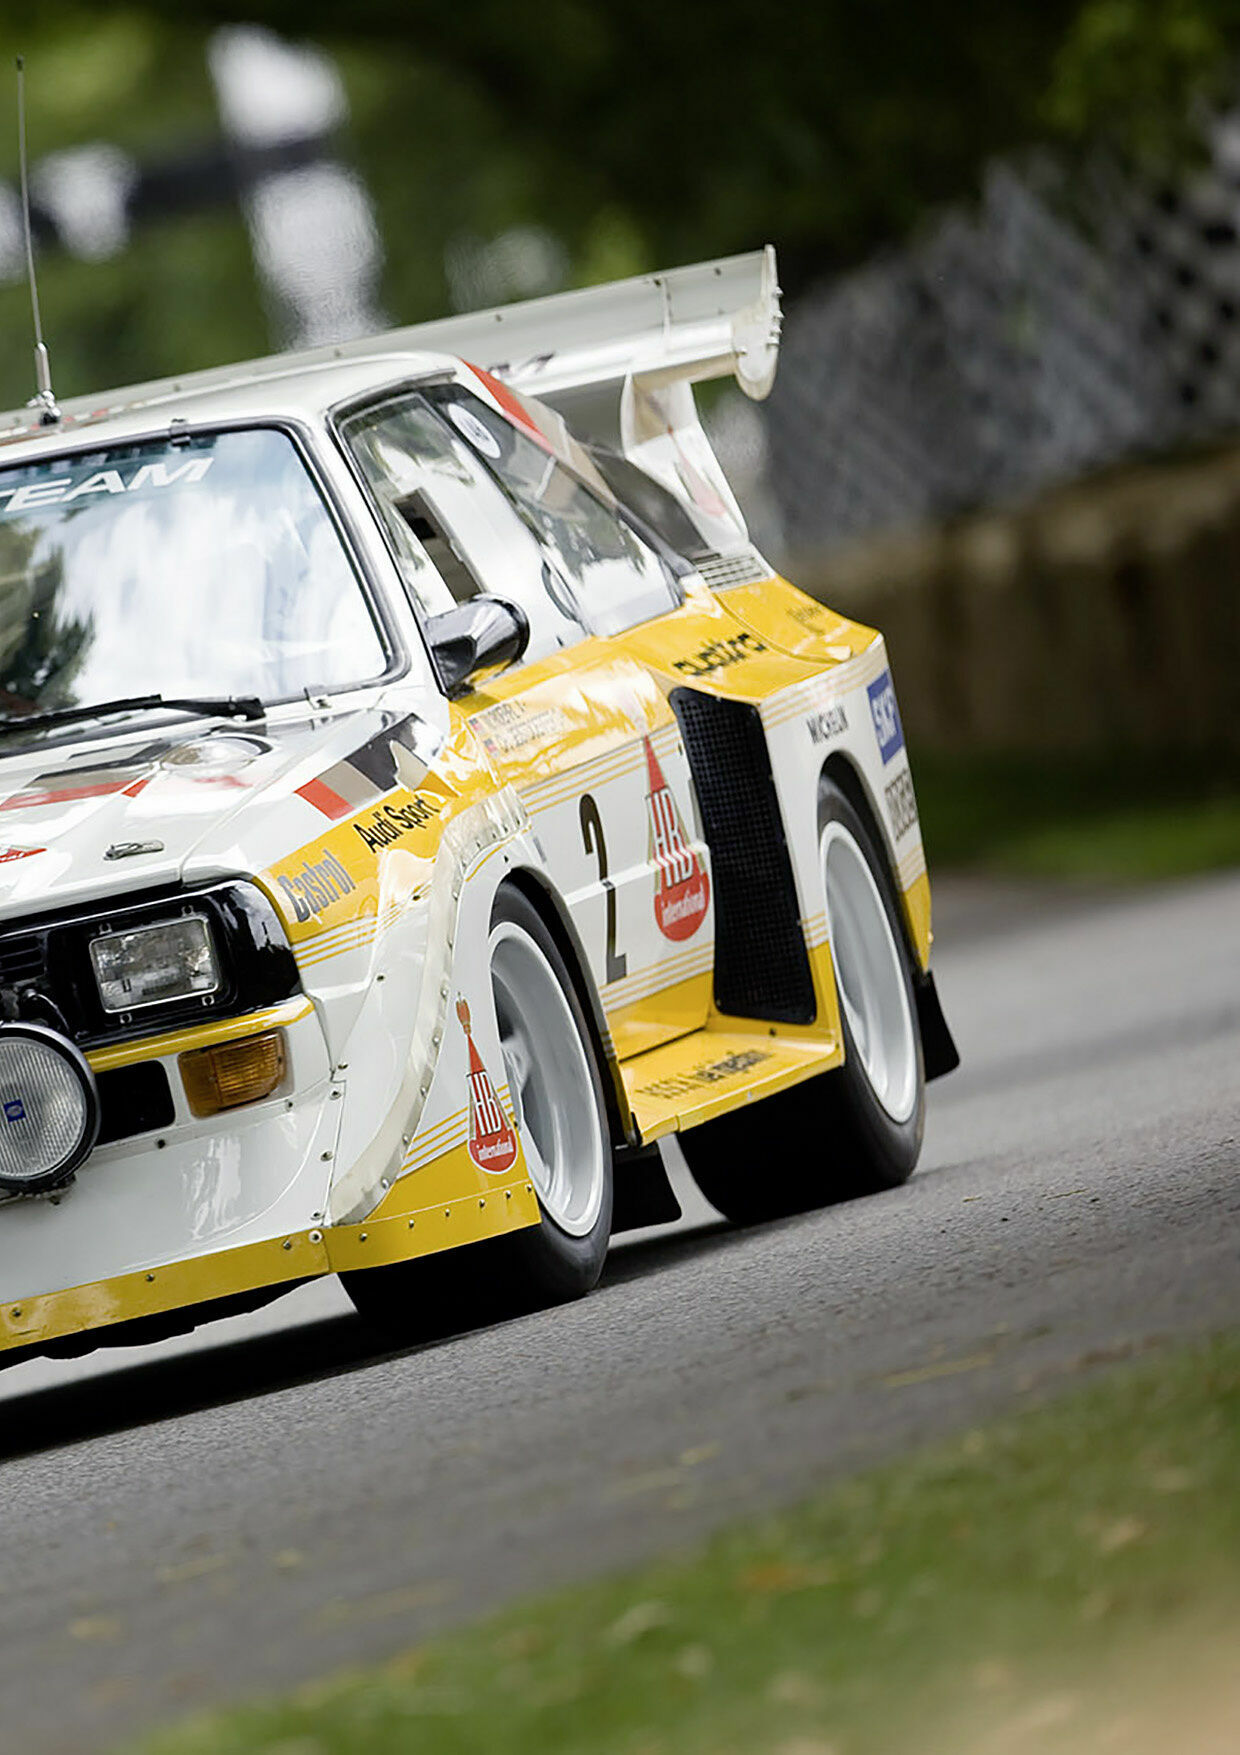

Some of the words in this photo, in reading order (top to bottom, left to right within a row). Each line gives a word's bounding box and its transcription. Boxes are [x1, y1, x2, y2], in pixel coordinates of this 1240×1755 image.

[353, 810, 404, 854] Audi
[383, 794, 441, 830] Sport
[277, 849, 356, 923] Castrol
[579, 794, 628, 985] 2
